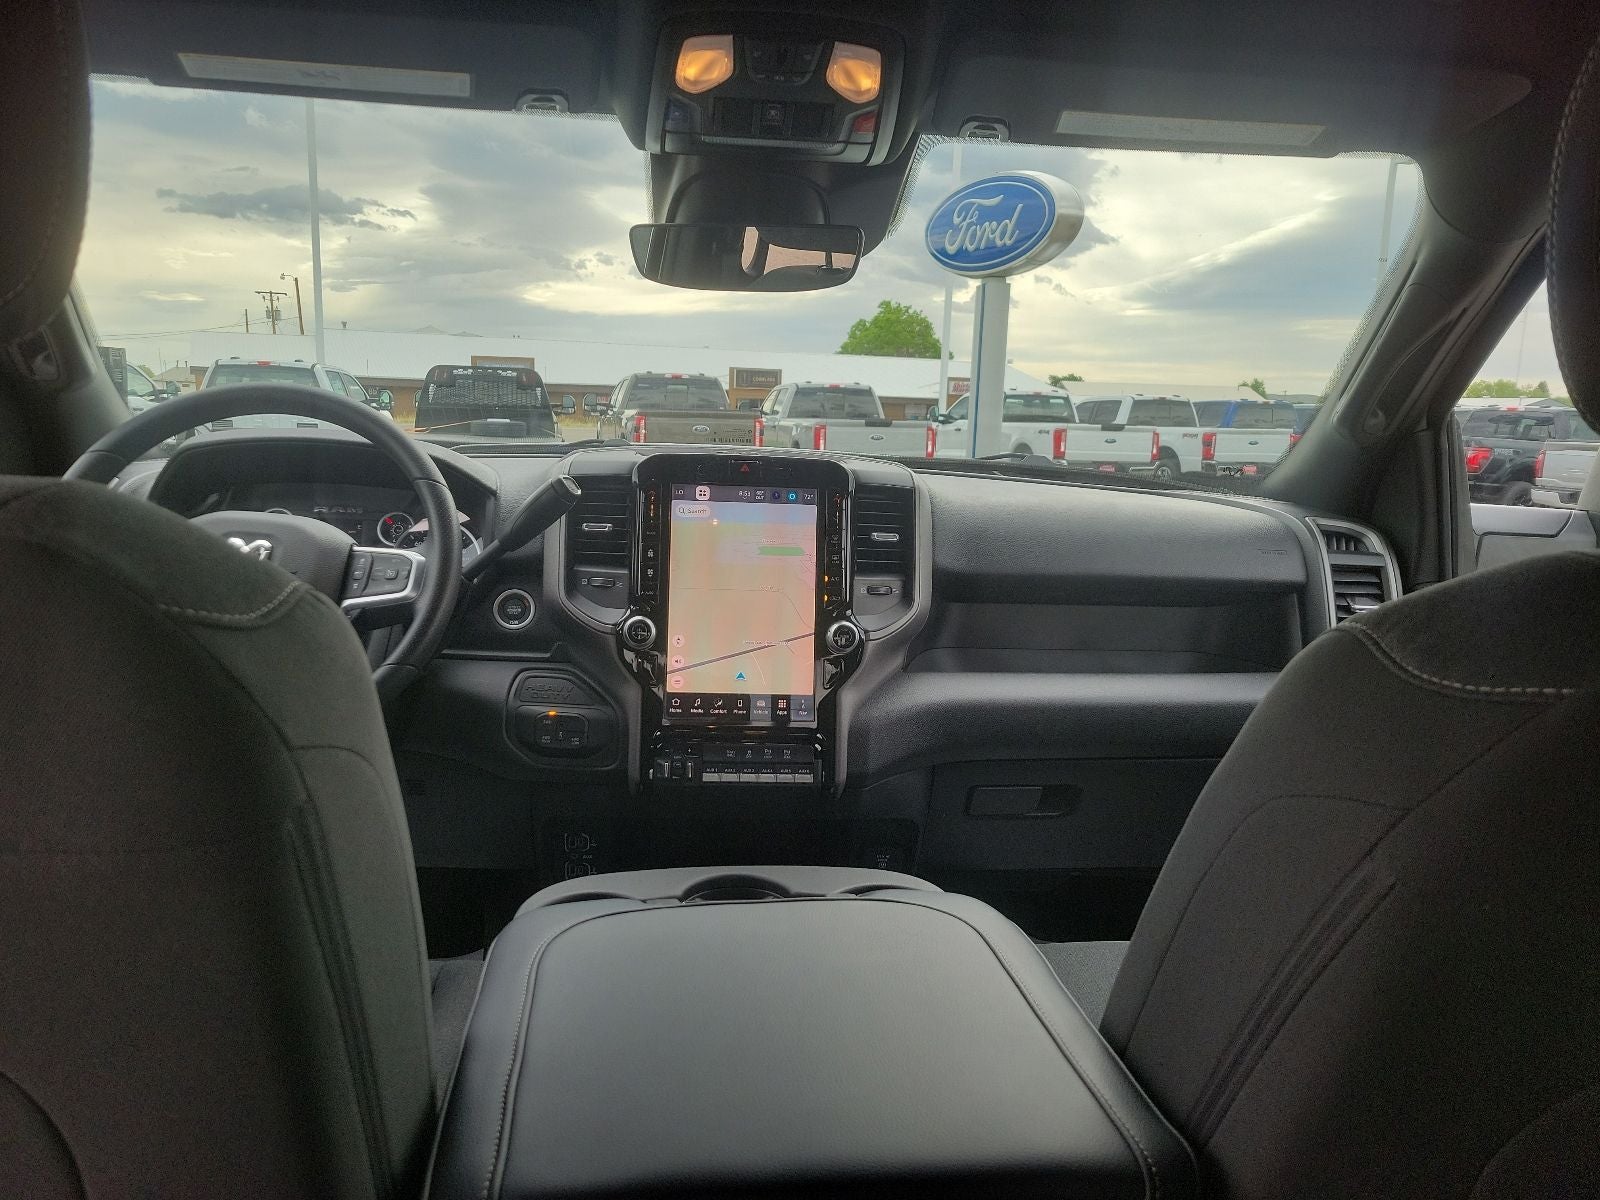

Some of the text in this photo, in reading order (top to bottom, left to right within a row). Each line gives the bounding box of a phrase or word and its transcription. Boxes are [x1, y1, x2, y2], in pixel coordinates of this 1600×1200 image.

[944, 194, 1024, 255] Ford
[687, 506, 707, 515] Search
[525, 683, 575, 692] HEAVY
[776, 709, 788, 717] Apps
